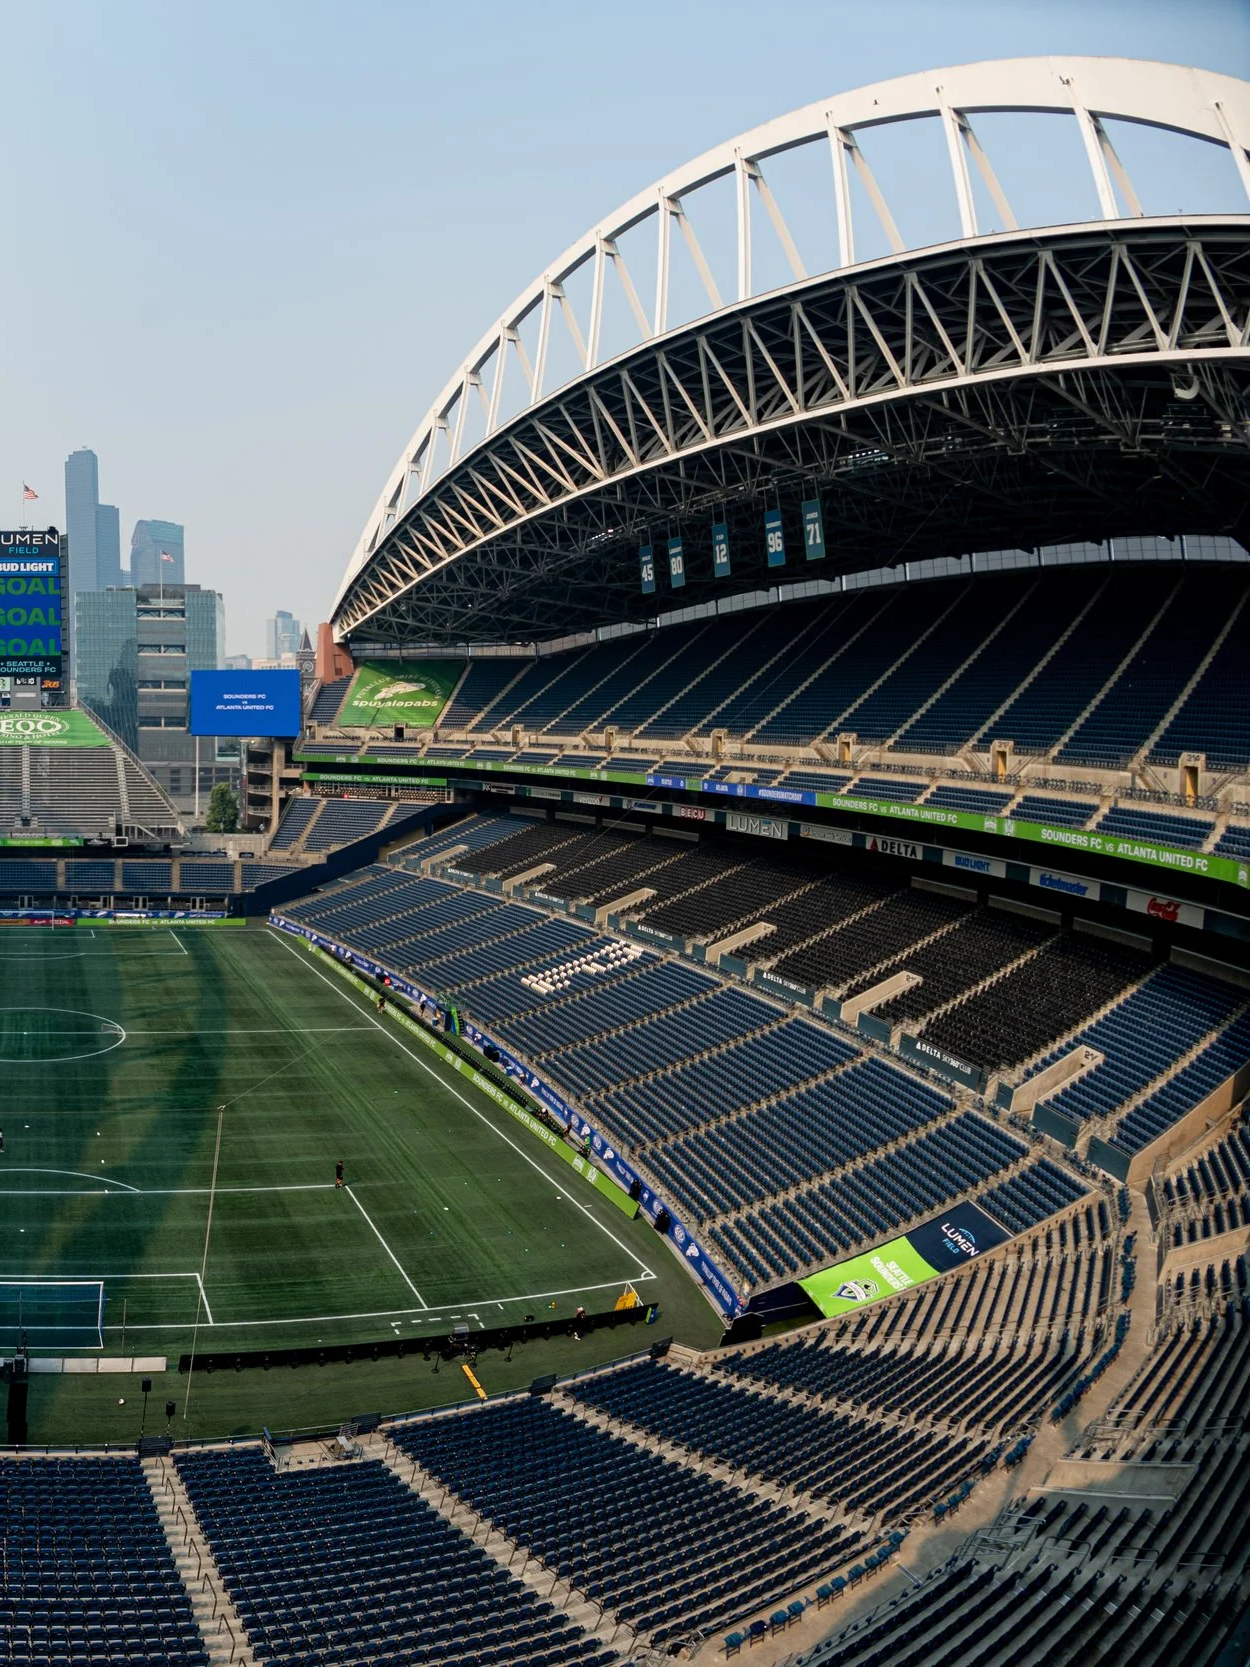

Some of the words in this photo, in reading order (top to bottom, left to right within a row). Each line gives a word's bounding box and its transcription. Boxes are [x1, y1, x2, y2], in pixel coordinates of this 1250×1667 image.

[768, 532, 782, 552] 96
[807, 523, 821, 545] 71
[716, 544, 727, 563] 12
[20, 563, 54, 571] LIGHT
[642, 564, 653, 581] 45
[671, 556, 682, 575] 80
[33, 713, 62, 722] QUEEN
[32, 731, 63, 739] HOTEL
[579, 796, 600, 805] verizon
[758, 789, 802, 801] #SOUNDERSMATCHDAY
[680, 807, 704, 819] BECU
[832, 798, 868, 810] SOUNDERS
[890, 806, 919, 818] ATLANTA
[921, 810, 946, 821] UNITED
[948, 814, 957, 823] FC
[729, 815, 782, 838] LUMEN
[881, 840, 917, 858] DELTA
[1041, 829, 1088, 847] SOUNDERS
[1090, 838, 1102, 849] FC
[1118, 844, 1157, 860] ATLANTA
[1159, 850, 1193, 868] UNITED
[1195, 858, 1208, 871] FC
[955, 856, 970, 867] BUD
[970, 857, 990, 872] LIGHT
[642, 926, 653, 934] DELTA
[767, 972, 782, 984] DELTA
[797, 985, 806, 994] CLUB
[922, 1044, 940, 1059] DELTA
[960, 1062, 971, 1075] CLUB
[473, 1074, 496, 1097] SOUNDERS
[496, 1092, 503, 1102] FC
[509, 1104, 530, 1124] ATLANTA
[530, 1119, 548, 1139] UNITED
[548, 1135, 556, 1146] FC
[941, 1222, 979, 1257] LUMEN
[942, 1238, 959, 1254] FIELD
[870, 1256, 902, 1289] SOUNDERS
[886, 1260, 914, 1285] SEATTLE
